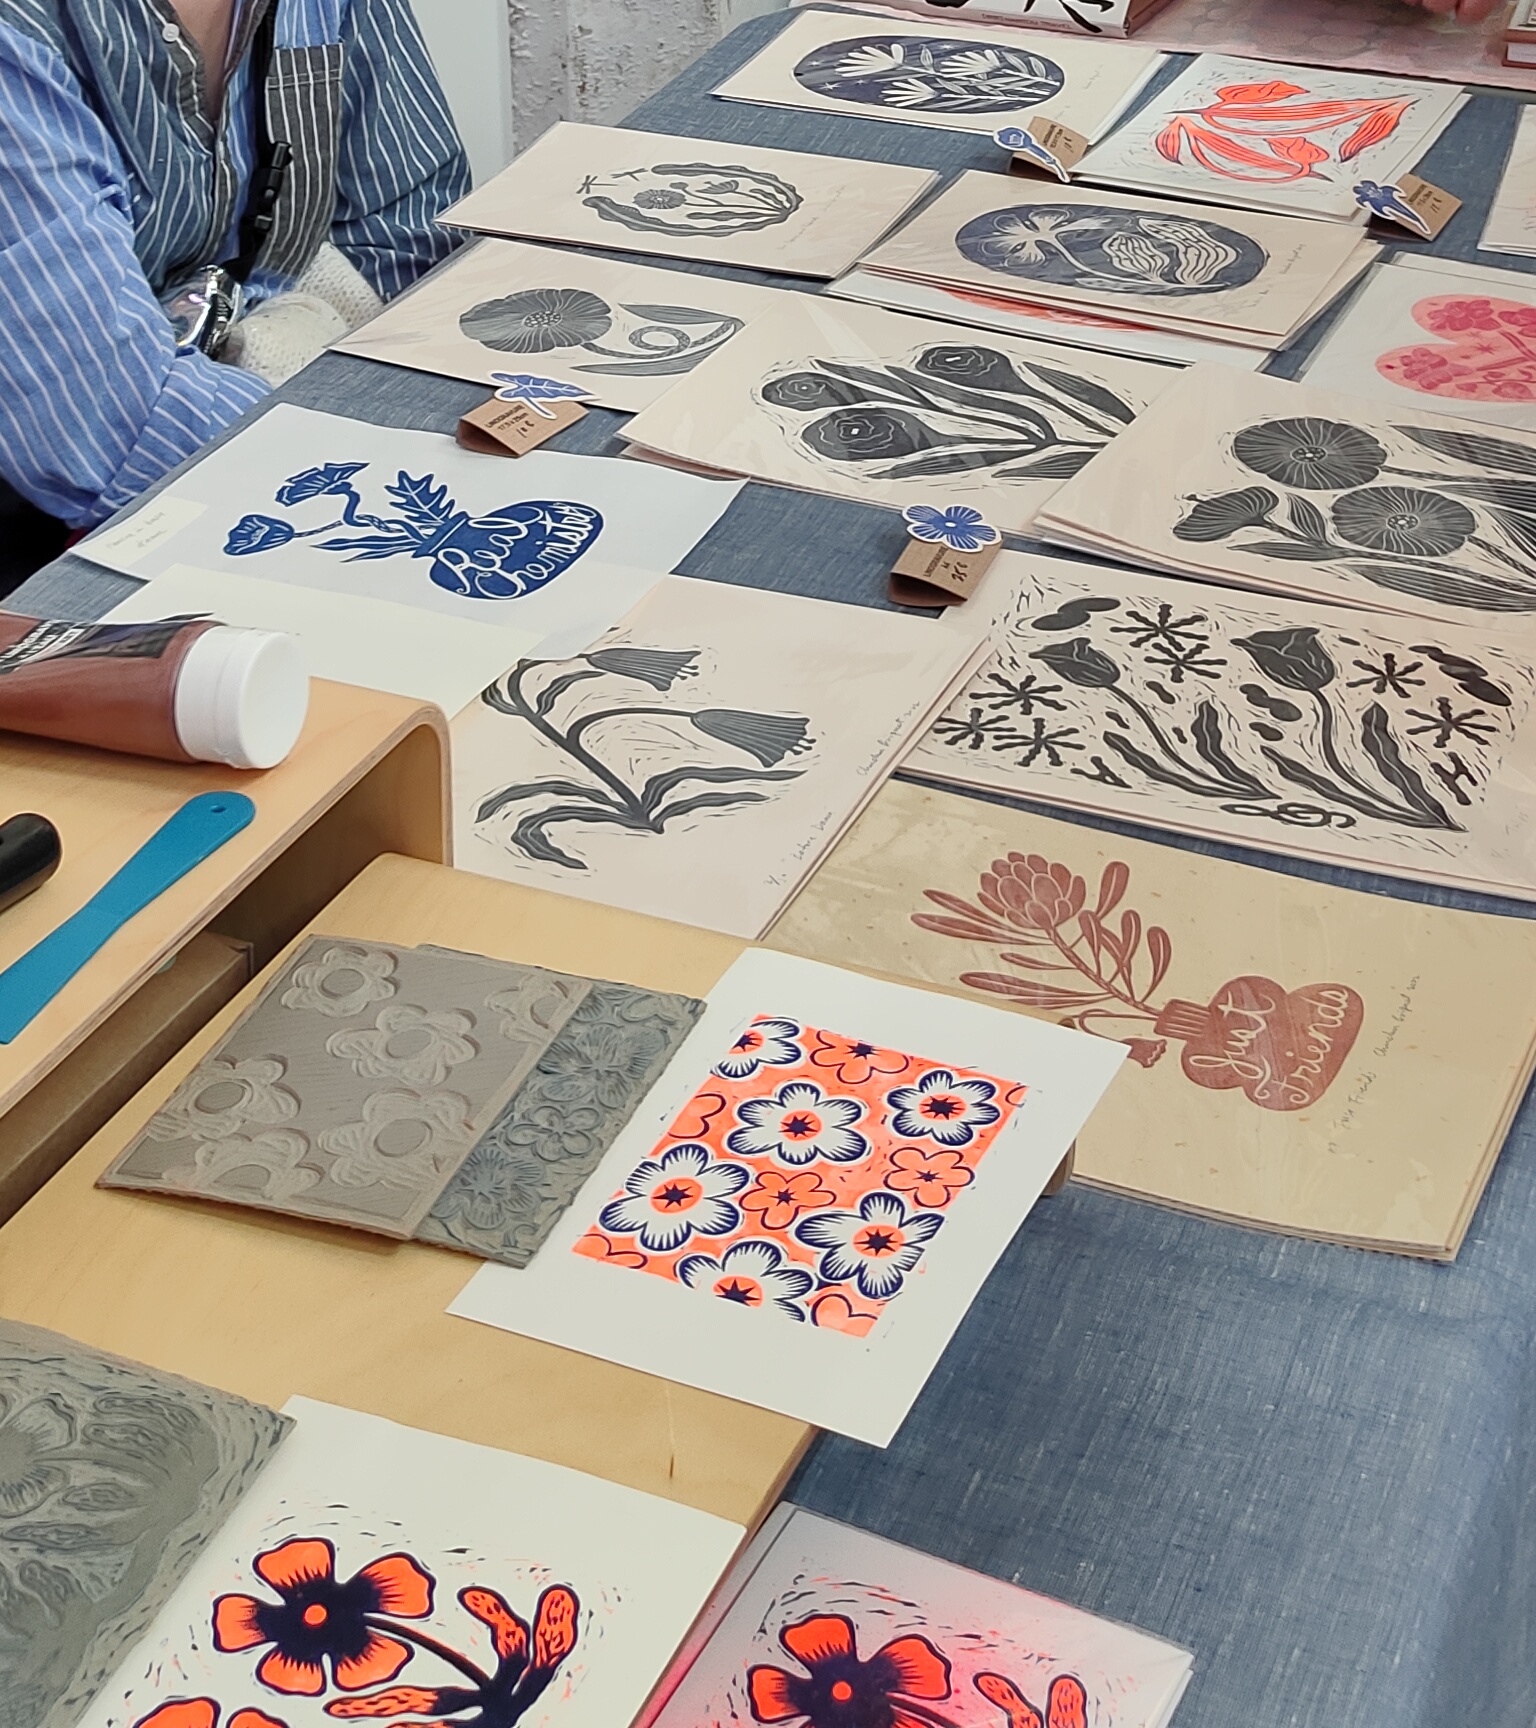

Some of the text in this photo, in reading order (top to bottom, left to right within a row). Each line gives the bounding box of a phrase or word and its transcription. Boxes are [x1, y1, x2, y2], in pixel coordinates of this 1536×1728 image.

[437, 505, 544, 595] Real
[475, 502, 599, 599] Chemistry
[1189, 990, 1277, 1099] Just
[1272, 988, 1350, 1105] Friends
